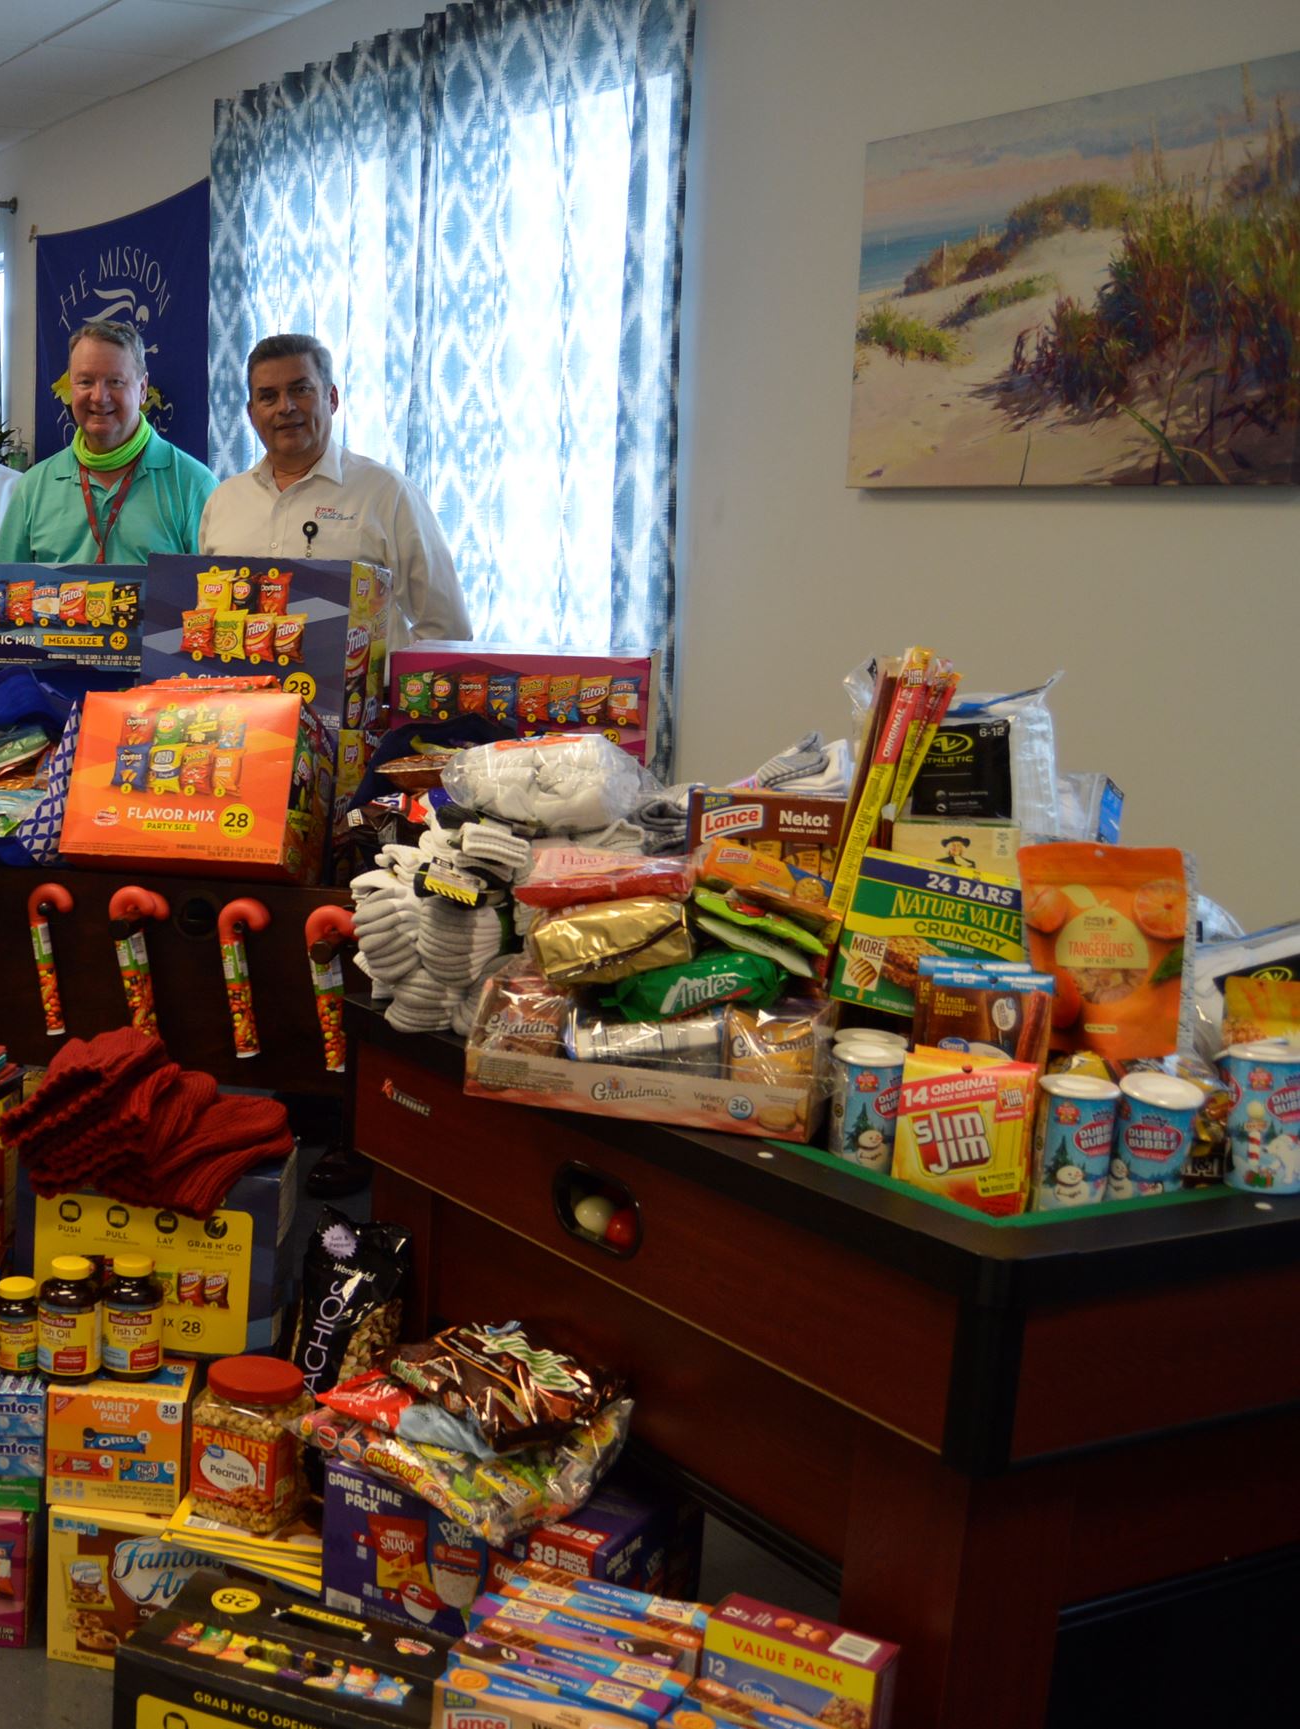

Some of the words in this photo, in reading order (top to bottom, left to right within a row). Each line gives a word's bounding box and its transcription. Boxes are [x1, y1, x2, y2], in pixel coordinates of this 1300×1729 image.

[59, 269, 90, 332] THE
[100, 246, 171, 318] MISSION
[16, 635, 36, 646] MIX
[48, 636, 72, 645] MEGA
[75, 636, 98, 645] SIZE
[111, 635, 125, 648] 42
[289, 681, 310, 696] 28
[882, 706, 907, 759] ORIGINAL
[979, 725, 1006, 738] 6-12
[127, 807, 184, 821] FLAVOR
[188, 810, 215, 822] MIX
[224, 813, 248, 827] 28
[702, 809, 759, 833] Lance
[779, 809, 830, 827] Nekot
[719, 849, 750, 862] Lance
[926, 873, 952, 892] 24
[957, 880, 1014, 906] BARS
[913, 919, 1007, 954] CRUNCHY
[852, 935, 885, 956] MORE
[1067, 939, 1134, 958] TANGERINES
[660, 972, 739, 1015] Andes
[935, 993, 945, 1001] 14
[946, 996, 966, 1004] PACKS
[934, 1009, 964, 1017] WRAPPED
[935, 1002, 976, 1011] INDIVIDUALLY
[591, 1081, 673, 1102] Grandma's
[694, 1091, 725, 1104] Variety
[903, 1087, 928, 1106] 14
[931, 1077, 996, 1094] ORIGINAL
[731, 1099, 749, 1112] 36
[914, 1110, 985, 1144] slim
[1127, 1127, 1178, 1143] DUBBLE
[1127, 1138, 1179, 1152] BUBBLE
[58, 1224, 81, 1234] PUSH
[106, 1230, 128, 1240] PULL
[157, 1236, 174, 1246] LAY
[188, 1239, 213, 1249] GRAB
[227, 1243, 242, 1252] GO
[333, 1262, 375, 1282] Wonderful
[112, 1325, 130, 1337] Fish
[132, 1326, 147, 1337] Oil
[181, 1321, 201, 1334] 28
[91, 1400, 140, 1413] VARIETY
[162, 1405, 177, 1416] 30
[100, 1412, 131, 1424] PACK
[99, 1436, 135, 1447] OREO
[193, 1426, 269, 1461] PEANUTS
[209, 1464, 249, 1483] Peanuts
[328, 1472, 364, 1492] GAME
[368, 1484, 402, 1506] TIME
[345, 1493, 379, 1514] PACK
[531, 1541, 556, 1565] 38
[558, 1550, 587, 1565] SNACK
[558, 1561, 589, 1576] PACKS
[708, 1657, 725, 1677] 12
[732, 1636, 786, 1666] VALUE
[793, 1658, 844, 1686] PACK
